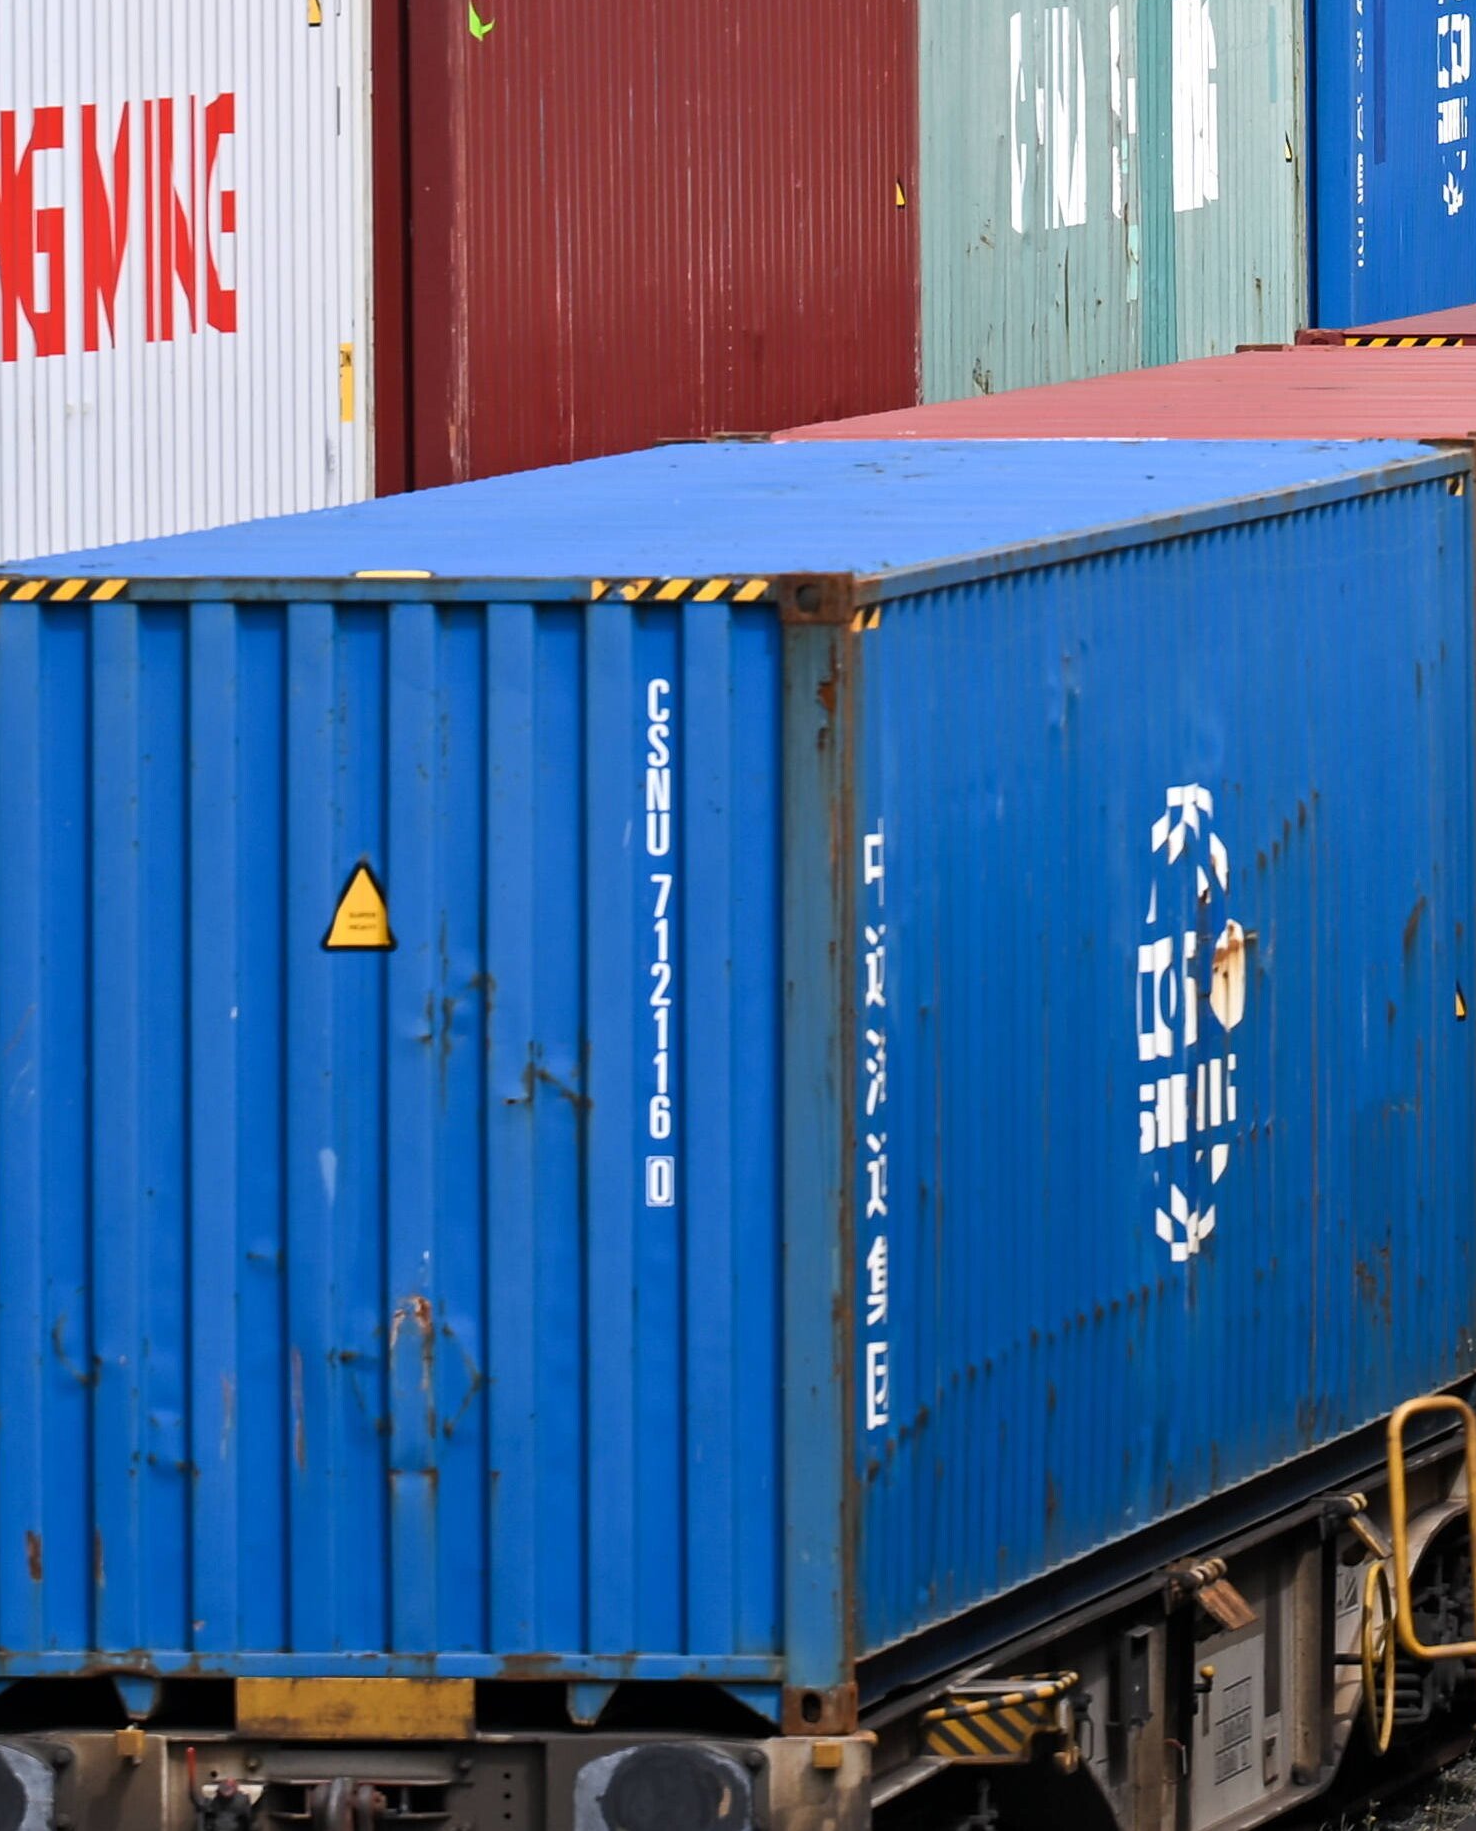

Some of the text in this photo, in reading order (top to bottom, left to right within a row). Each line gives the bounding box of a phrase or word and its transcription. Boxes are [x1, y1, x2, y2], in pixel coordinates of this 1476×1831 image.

[81, 92, 238, 352] MING
[646, 678, 671, 859] CSNU
[647, 874, 672, 1141] 712116
